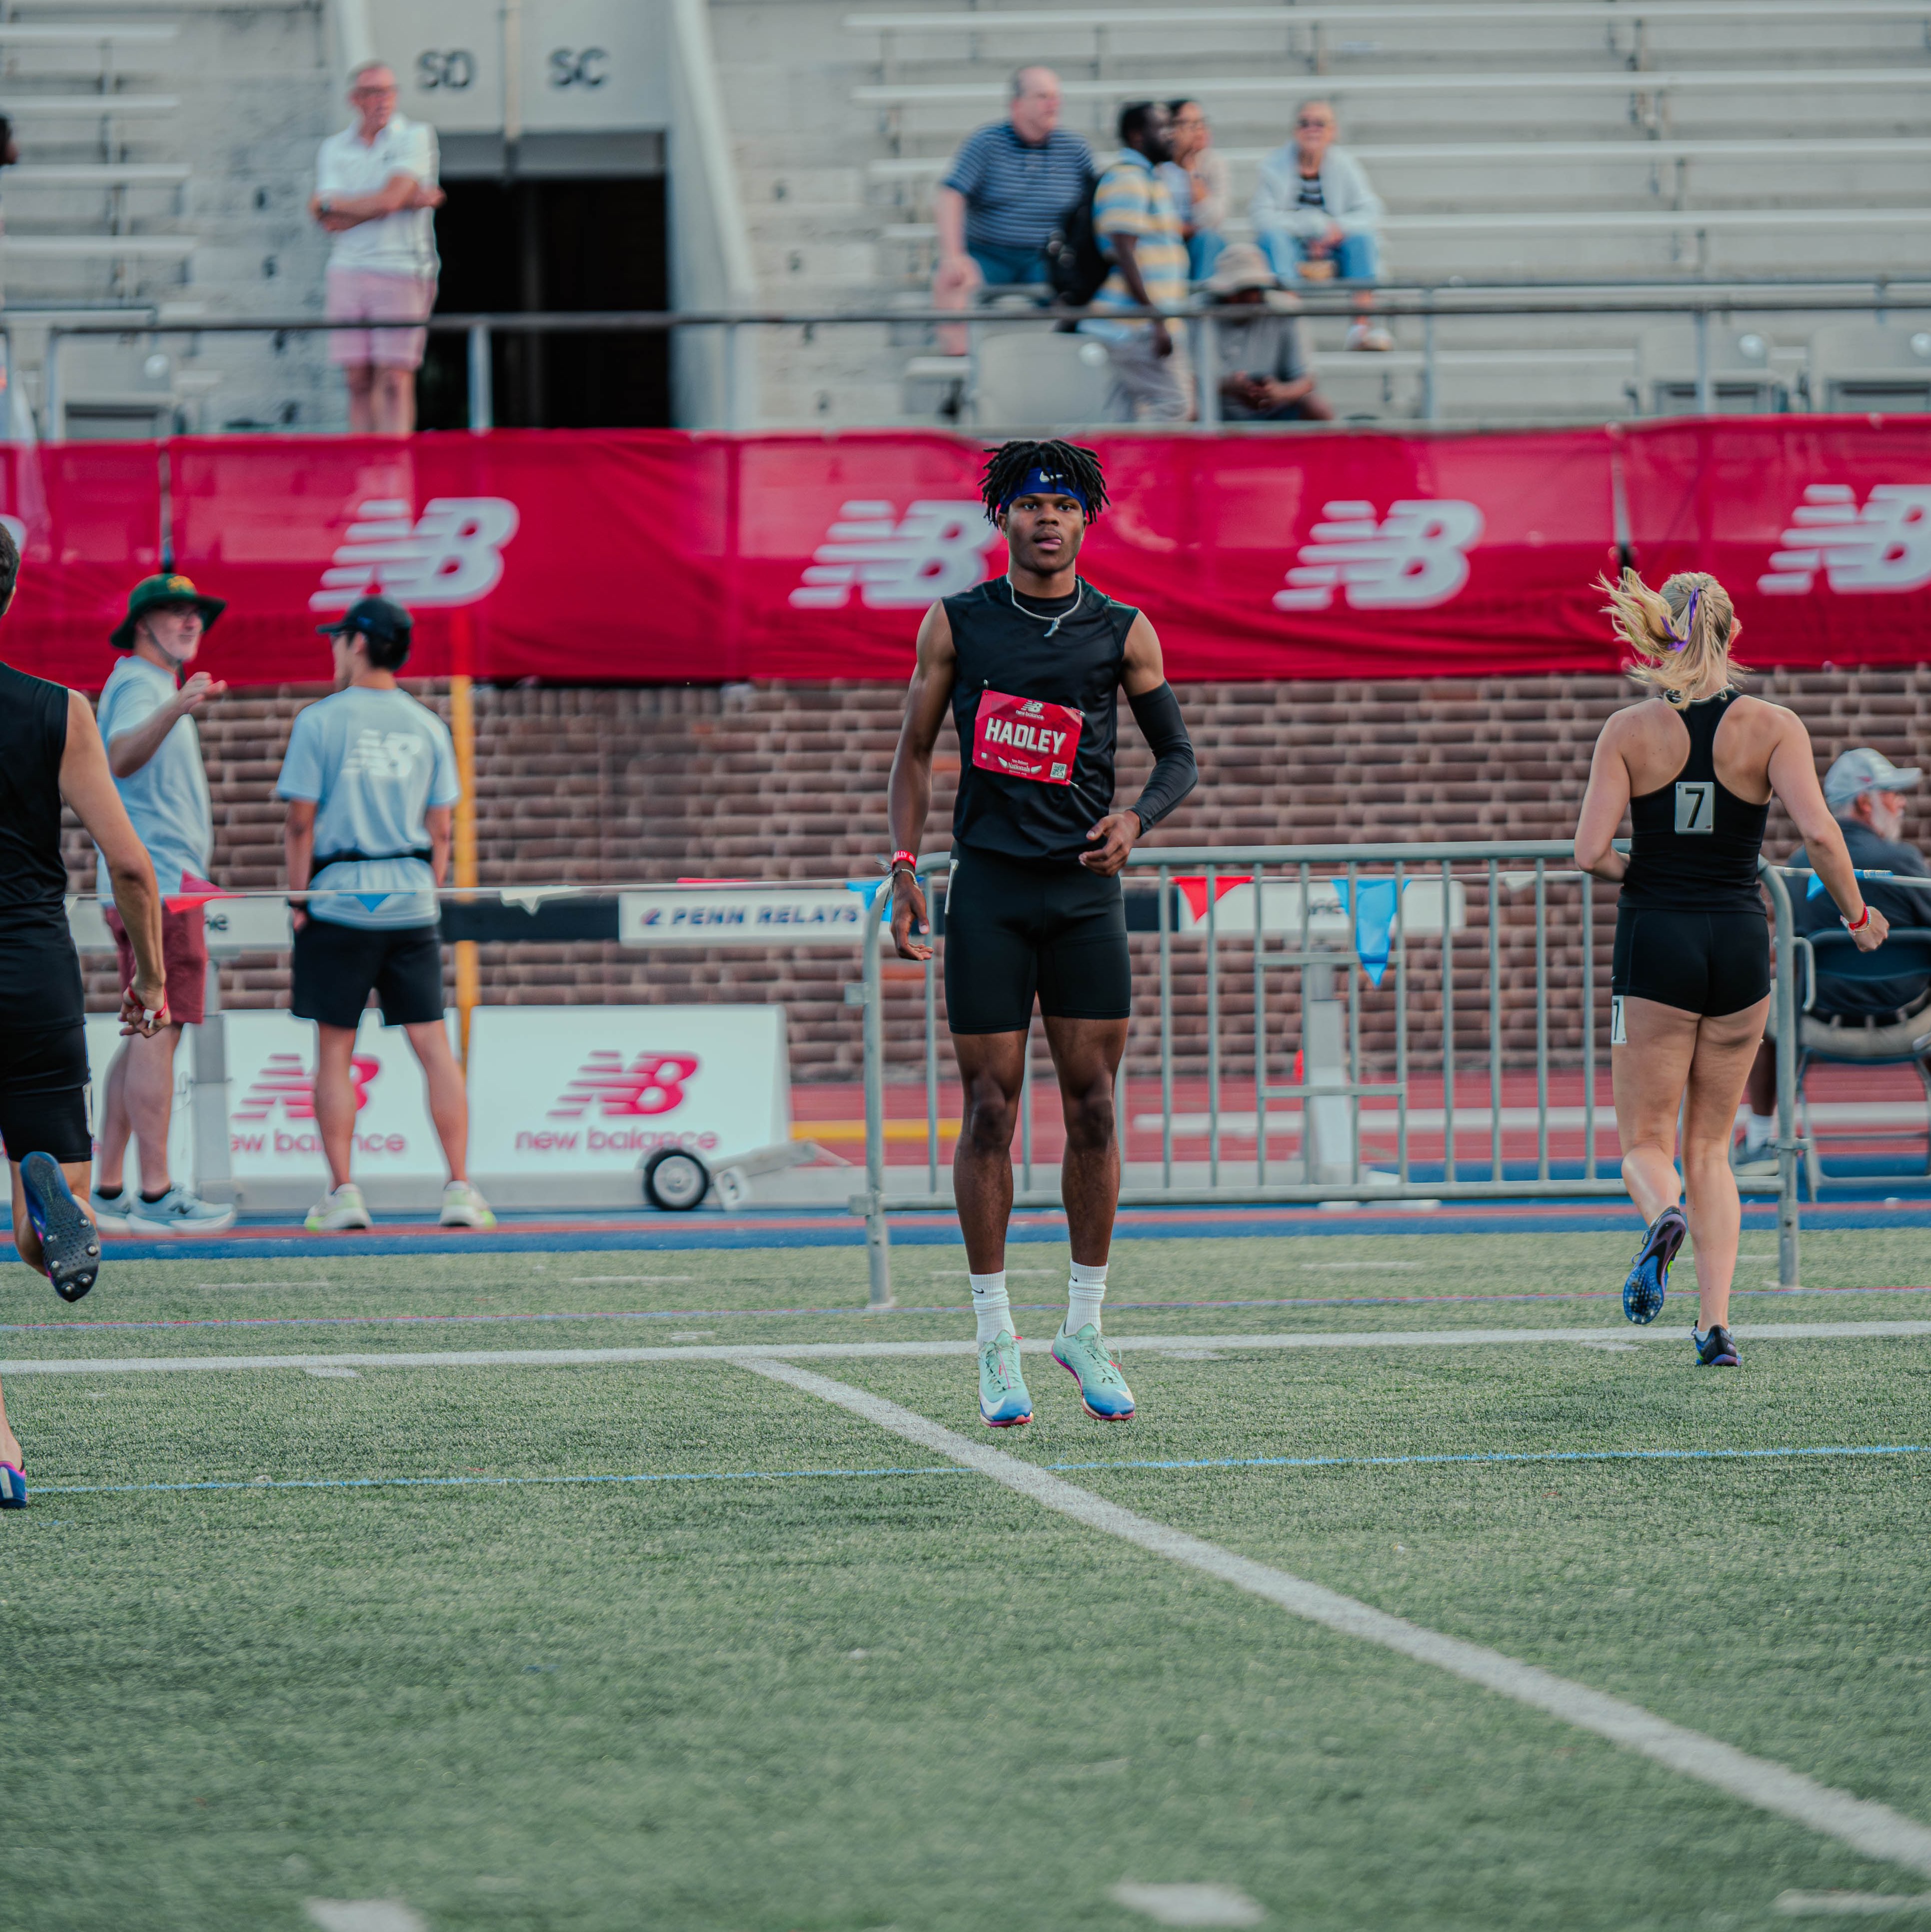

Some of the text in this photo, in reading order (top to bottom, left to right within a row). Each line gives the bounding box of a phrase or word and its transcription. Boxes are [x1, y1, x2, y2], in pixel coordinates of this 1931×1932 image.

[549, 46, 608, 89] SC
[984, 717, 1067, 755] HADLEY
[1008, 762, 1030, 773] Nationals
[1685, 787, 1705, 828] 7
[671, 904, 858, 925] PENN RELAYS
[1612, 999, 1620, 1040] 7
[231, 1133, 265, 1151] ew
[515, 1126, 720, 1151] new balance
